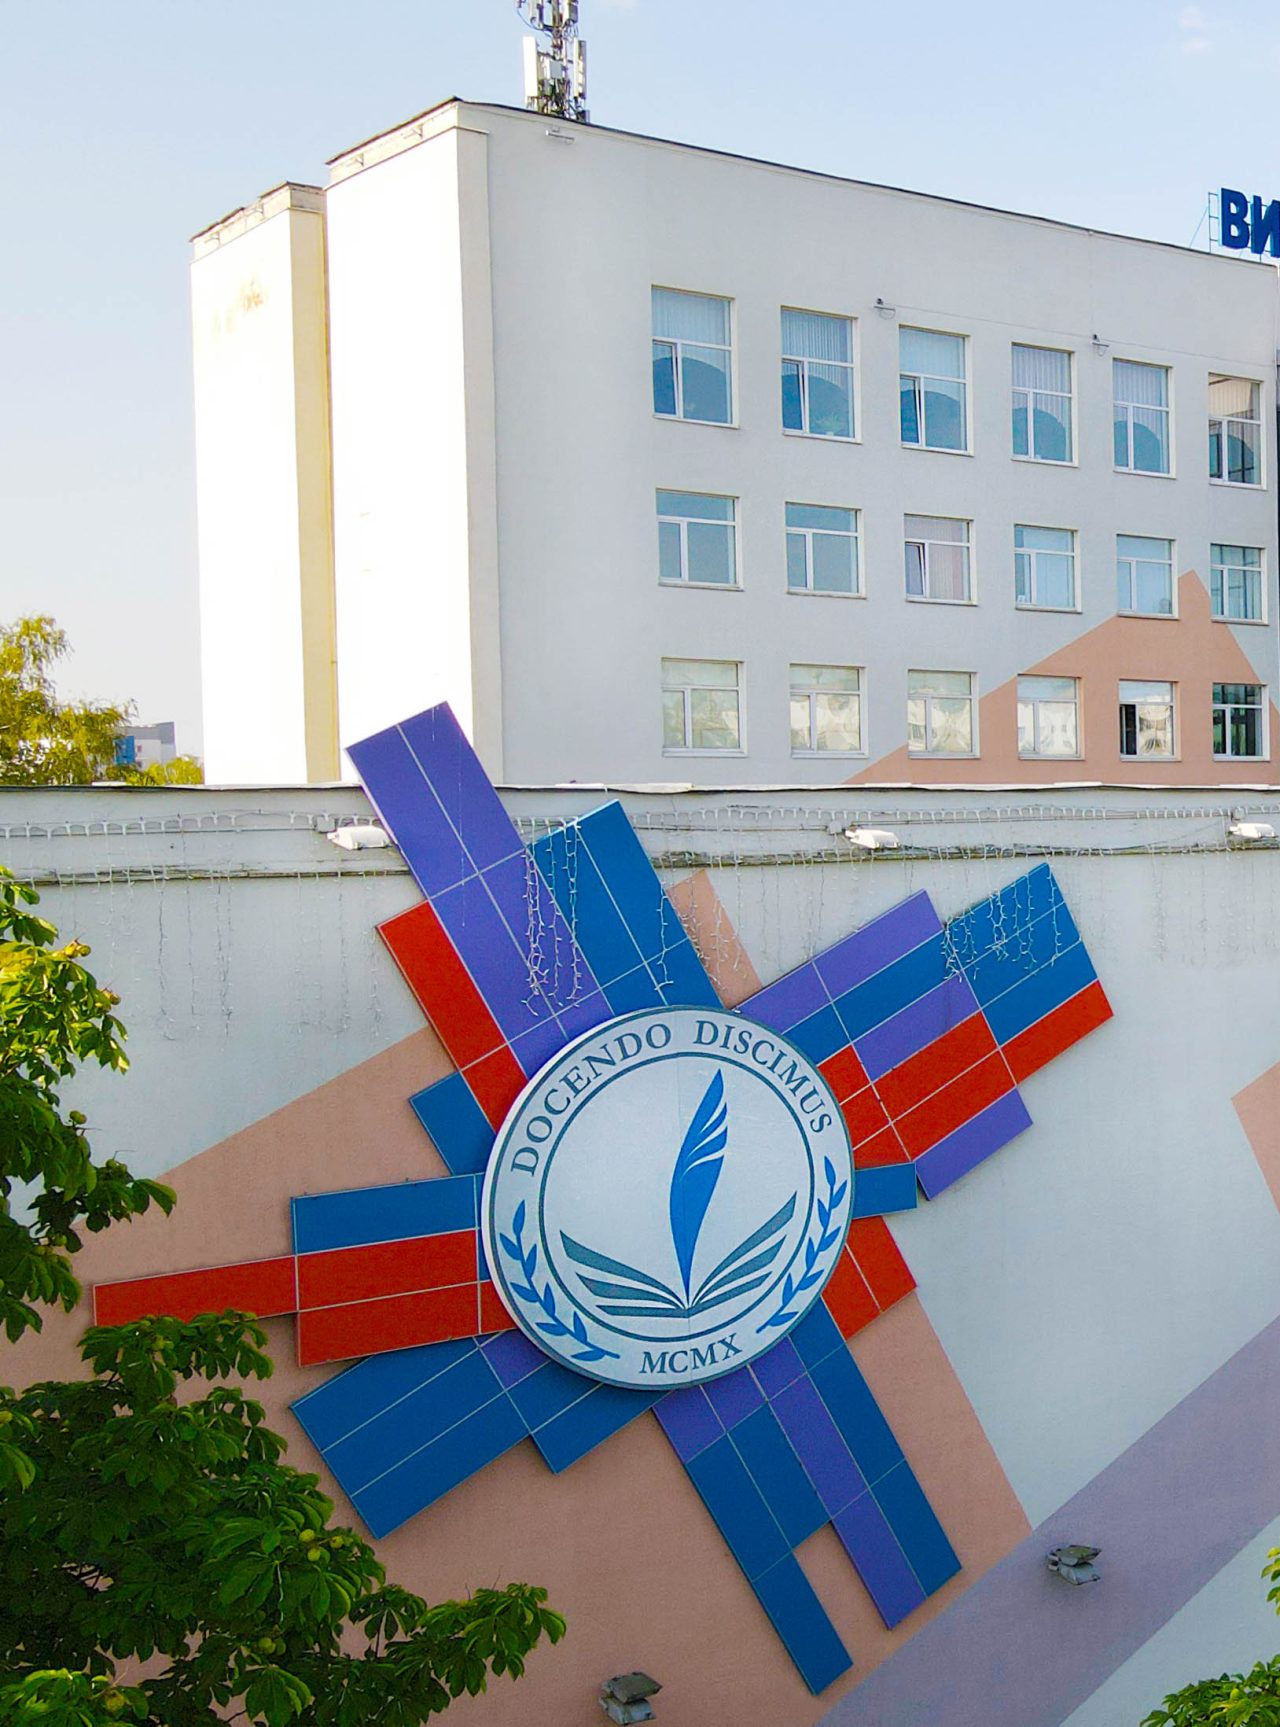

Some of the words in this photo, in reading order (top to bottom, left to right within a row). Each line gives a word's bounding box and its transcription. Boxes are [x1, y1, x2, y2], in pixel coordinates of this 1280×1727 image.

[510, 1023, 672, 1177] DOCENDO
[693, 1020, 832, 1134] DISCIMUS
[639, 1333, 742, 1375] MCMX
